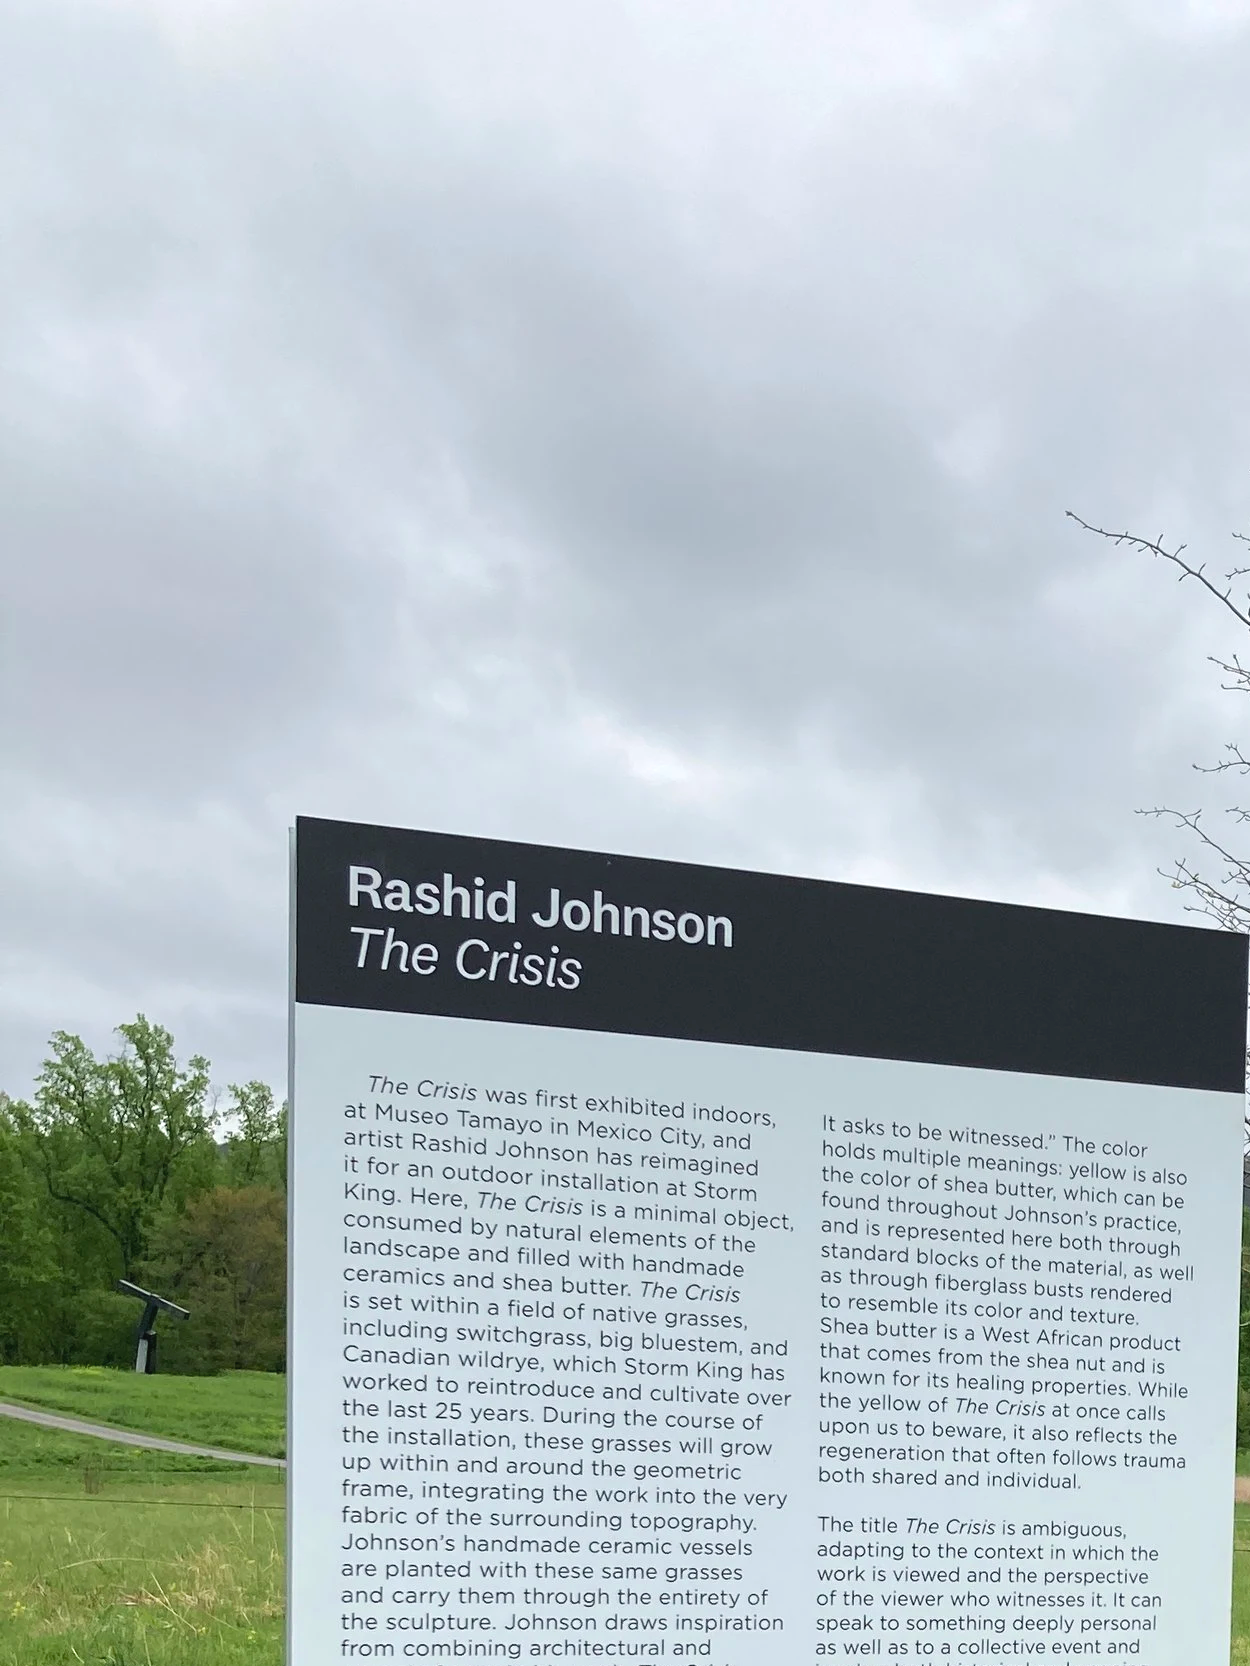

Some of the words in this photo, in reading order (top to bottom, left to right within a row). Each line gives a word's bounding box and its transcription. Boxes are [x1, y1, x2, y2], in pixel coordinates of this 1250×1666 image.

[349, 865, 516, 924] Rashid
[531, 887, 733, 948] Johnson
[350, 926, 439, 975] The
[456, 938, 582, 990] Crisis
[369, 1075, 409, 1096] The
[417, 1079, 478, 1101] Crisis
[485, 1088, 528, 1106] was
[535, 1088, 578, 1110] first
[585, 1095, 685, 1119] exhibited
[693, 1102, 776, 1129] indoors,
[343, 1129, 404, 1150] artist
[412, 1132, 487, 1156] Rashid
[495, 1139, 589, 1164] Johnson
[597, 1146, 633, 1167] has
[641, 1151, 759, 1177] reimagined
[823, 1114, 836, 1132] It
[842, 1117, 885, 1137] asks
[891, 1121, 912, 1139] to
[918, 1122, 943, 1141] be
[1062, 1135, 1096, 1155] The
[1102, 1140, 1148, 1158] color
[343, 1213, 462, 1234] consumed
[471, 1217, 498, 1240] by
[506, 1222, 582, 1242] natural
[589, 1225, 687, 1249] elements
[694, 1233, 717, 1251] of
[722, 1234, 756, 1253] the
[821, 1190, 880, 1211] found
[886, 1195, 998, 1220] throughout
[1104, 1215, 1182, 1236] practice,
[343, 1317, 448, 1343] including
[456, 1324, 592, 1350] switchgrass,
[600, 1329, 633, 1352] big
[641, 1332, 743, 1357] bluestem,
[750, 1339, 788, 1357] and
[820, 1316, 869, 1336] Shea
[876, 1319, 938, 1339] butter
[944, 1323, 958, 1341] is
[964, 1328, 975, 1341] a
[981, 1325, 1030, 1345] West
[1036, 1328, 1103, 1348] African
[1109, 1333, 1182, 1352] product
[820, 1366, 885, 1386] known
[892, 1369, 921, 1387] for
[927, 1371, 950, 1389] its
[956, 1372, 1025, 1395] healing
[1031, 1379, 1132, 1397] properties.
[1137, 1381, 1189, 1399] While
[342, 1398, 380, 1418] the
[387, 1399, 427, 1419] last
[435, 1401, 462, 1420] 25
[469, 1407, 534, 1424] years.
[543, 1406, 616, 1429] During
[623, 1408, 658, 1428] the
[665, 1414, 735, 1430] course
[742, 1413, 764, 1431] of
[463, 1534, 581, 1554] handmade
[588, 1537, 673, 1555] ceramic
[679, 1538, 753, 1556] vessels
[817, 1515, 854, 1533] The
[860, 1516, 898, 1534] title
[906, 1517, 940, 1535] The
[946, 1518, 997, 1536] Crisis
[1002, 1519, 1016, 1536] is
[1021, 1520, 1127, 1540] ambiguous,
